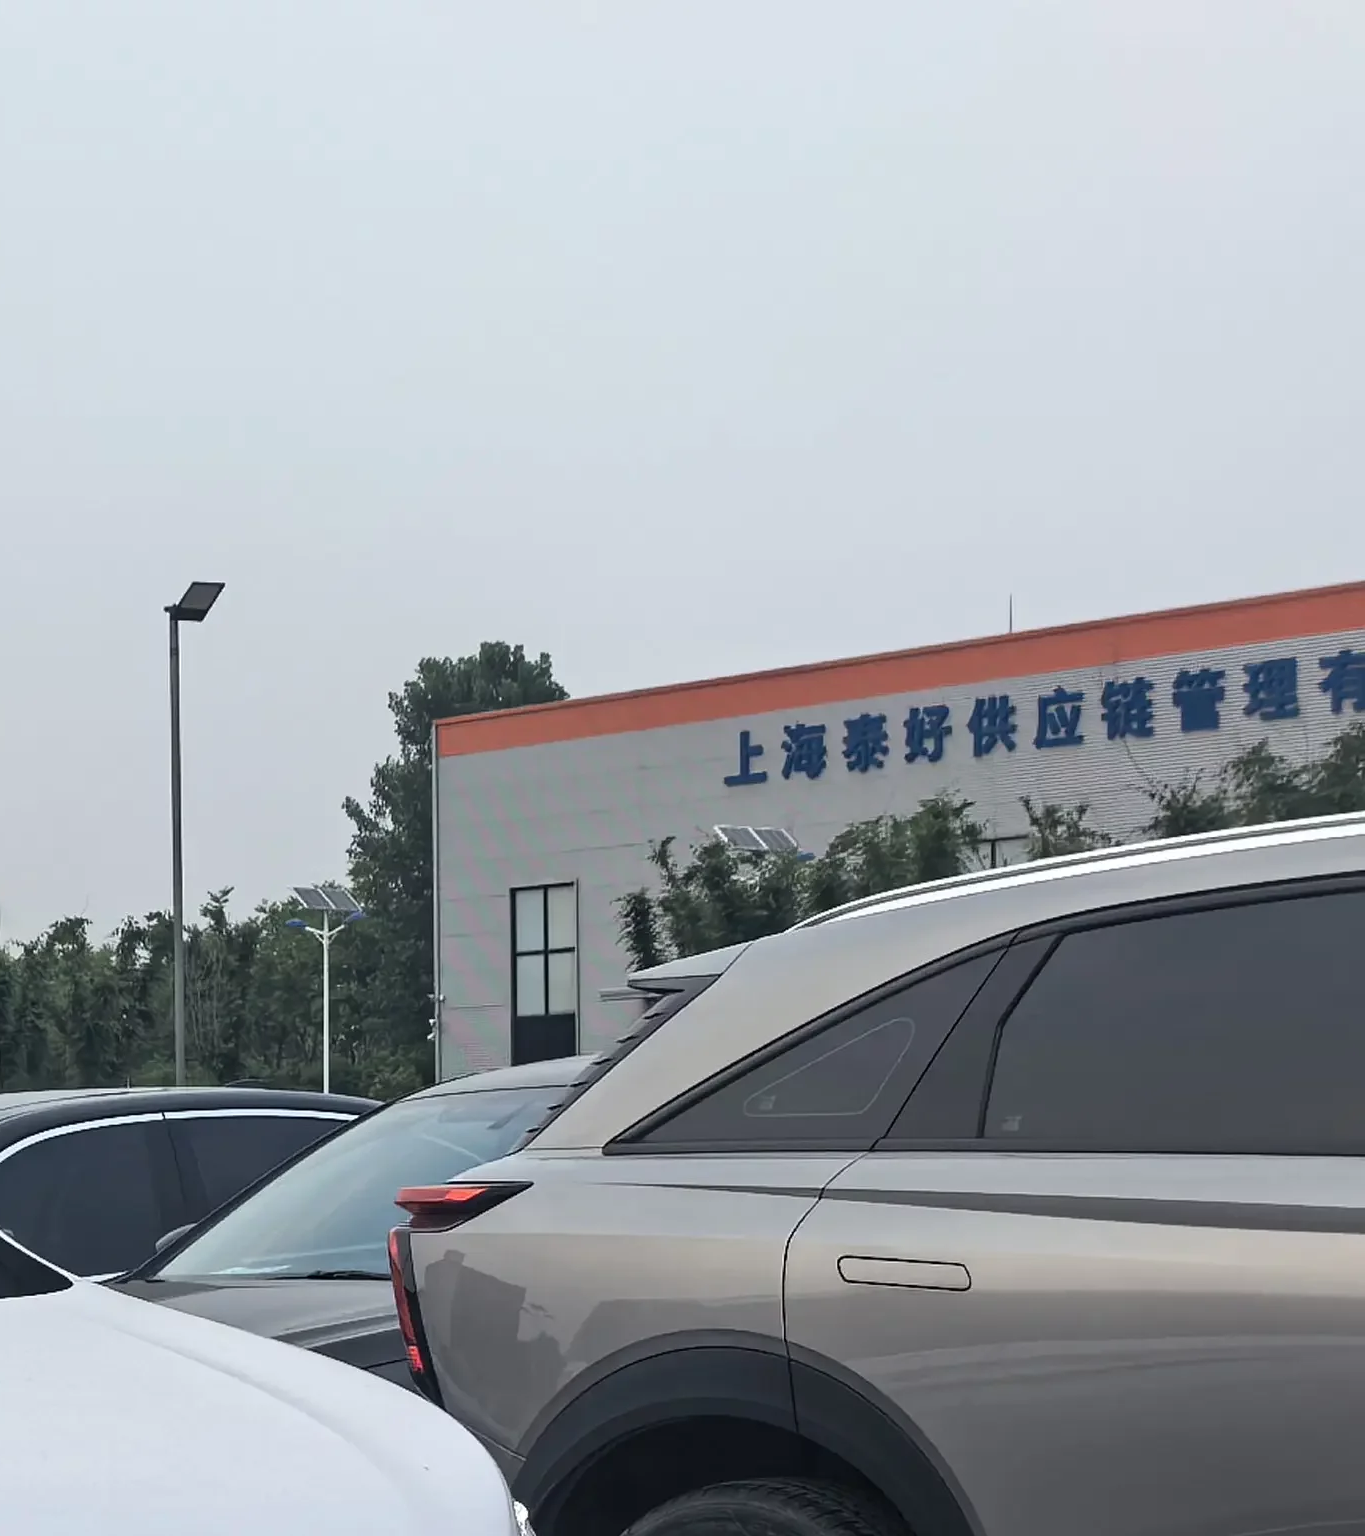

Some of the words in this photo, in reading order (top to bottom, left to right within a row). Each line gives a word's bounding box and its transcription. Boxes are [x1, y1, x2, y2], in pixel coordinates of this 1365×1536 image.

[723, 649, 1365, 787] 上海泰好供应链管理有
